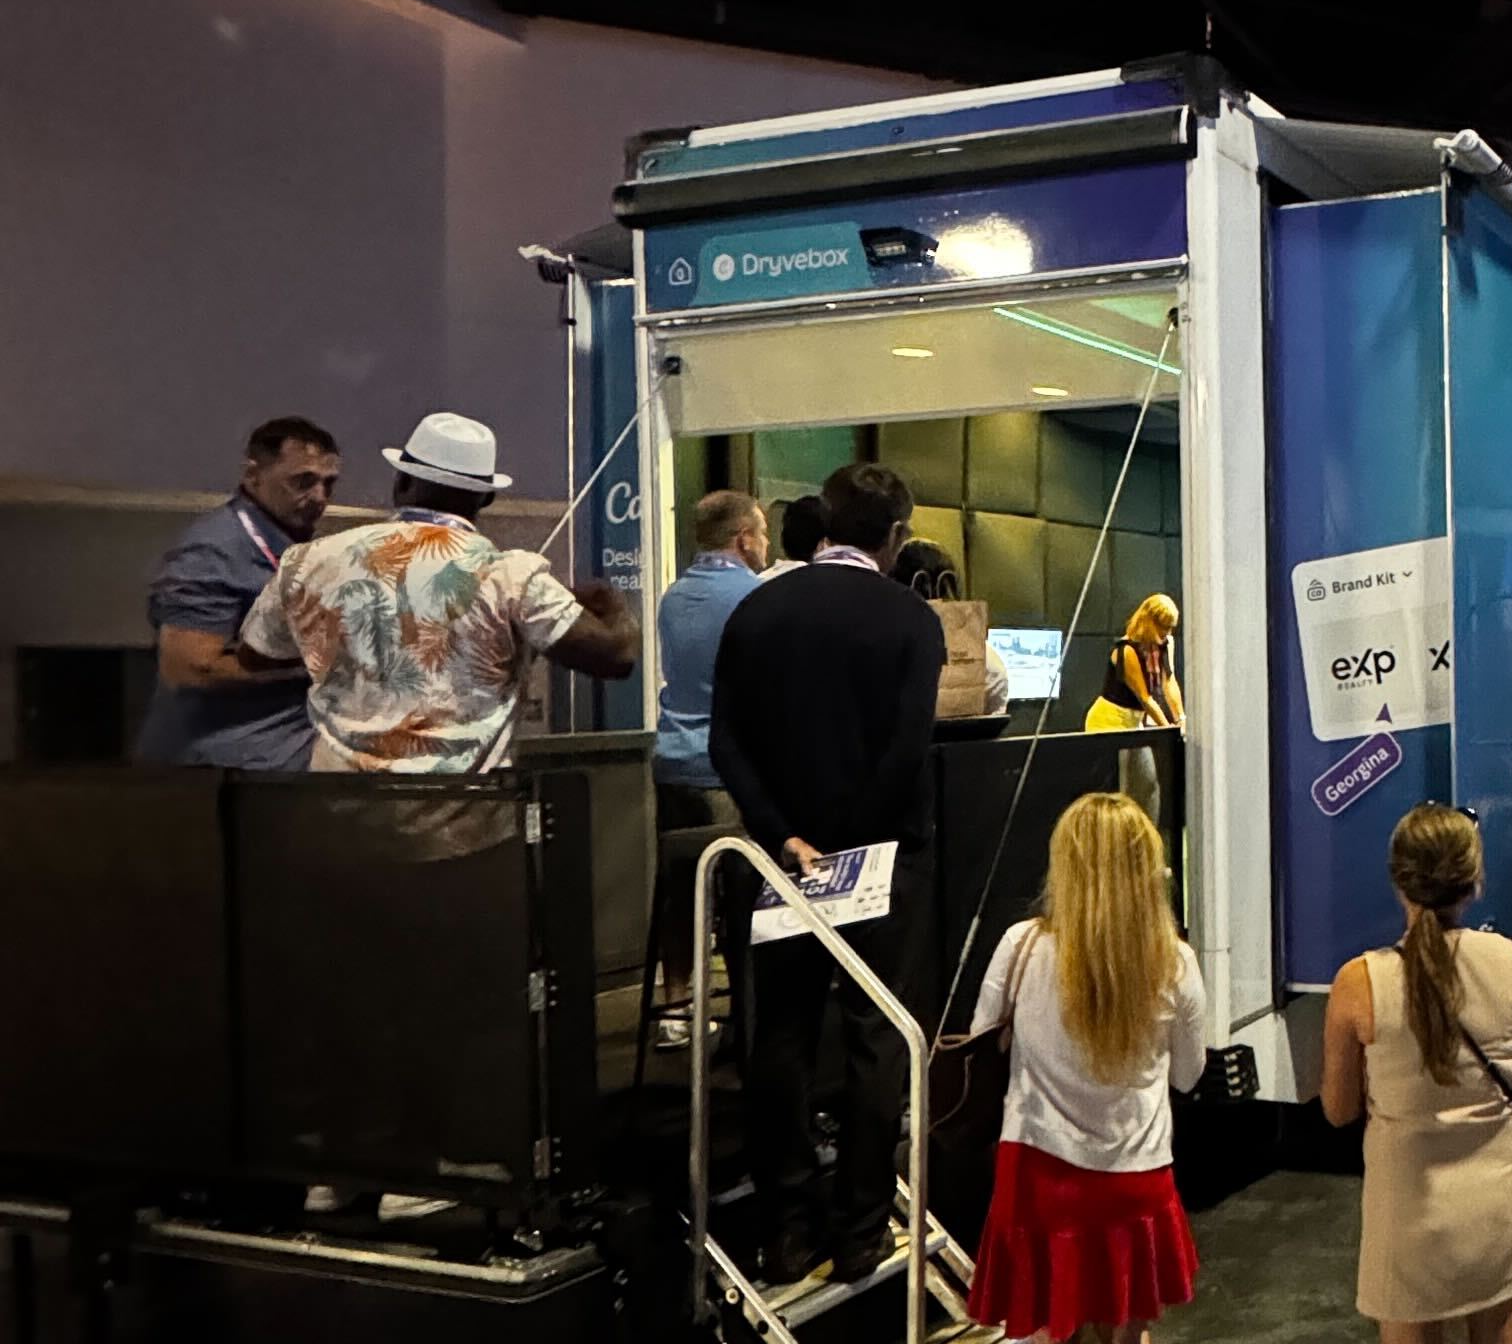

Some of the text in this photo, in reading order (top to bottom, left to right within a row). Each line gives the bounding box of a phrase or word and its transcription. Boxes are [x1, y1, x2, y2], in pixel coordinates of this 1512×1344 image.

[743, 248, 848, 276] Dryvebox
[1332, 575, 1372, 594] Brand
[1376, 572, 1396, 586] Kit
[1325, 747, 1390, 802] Georgina
